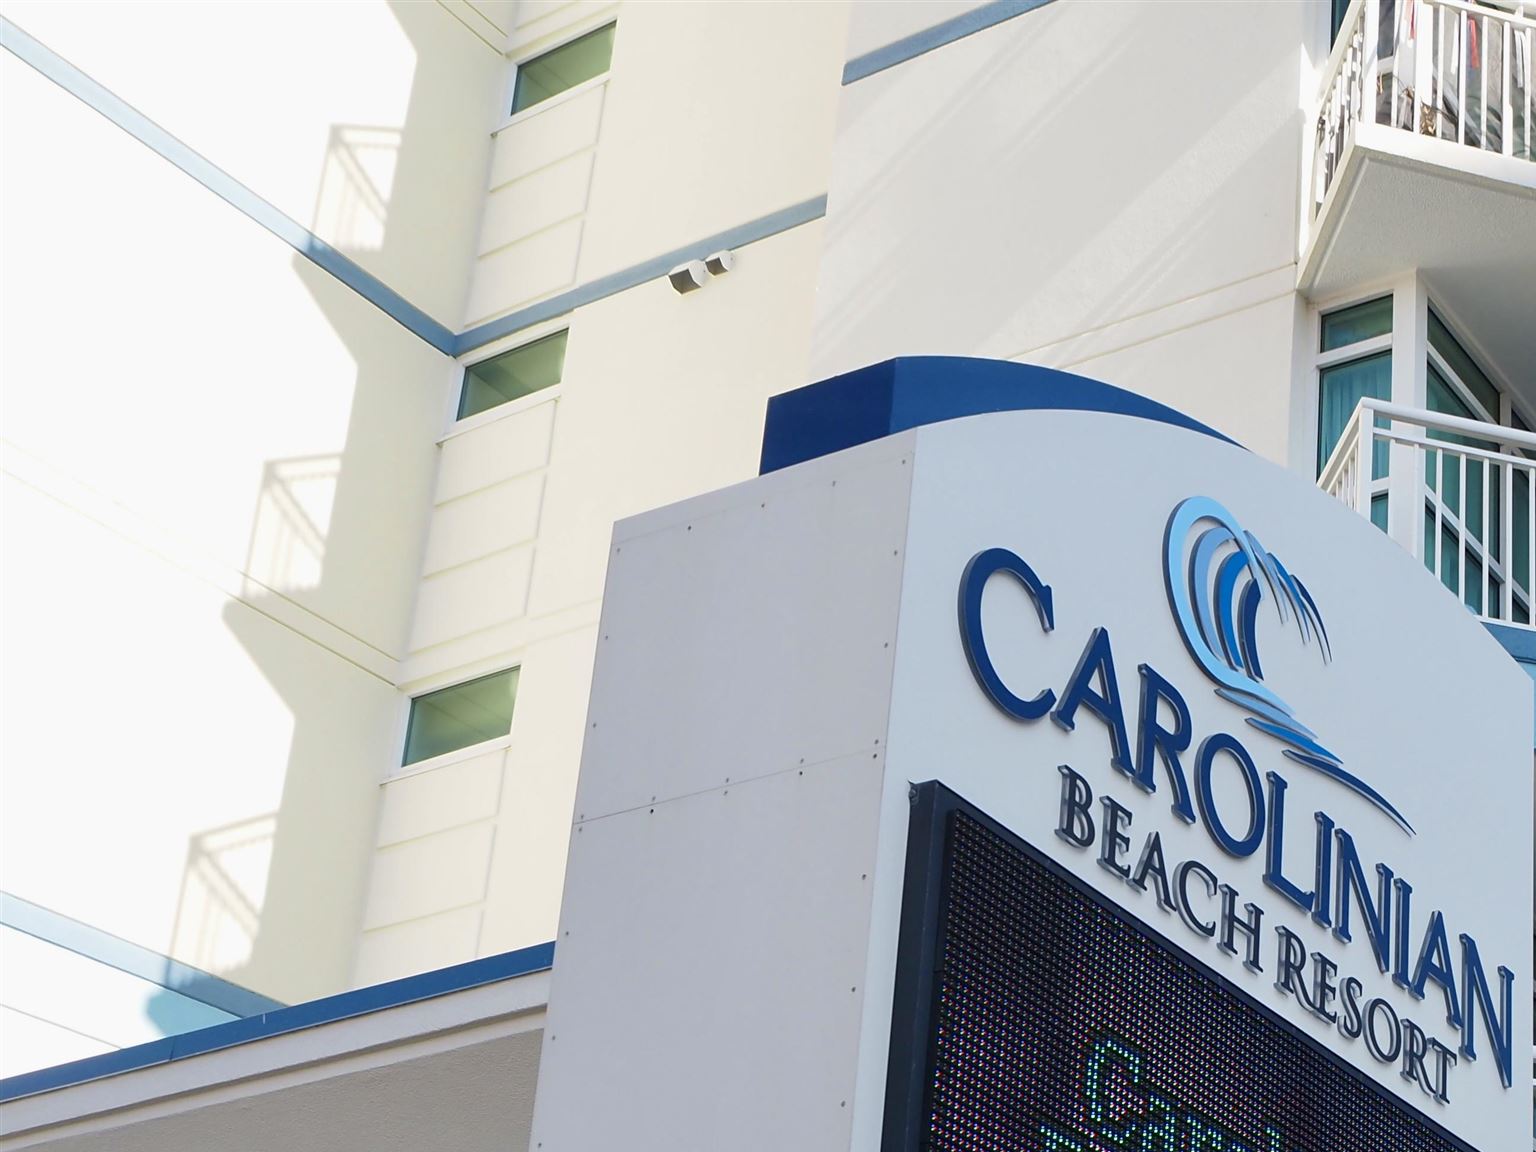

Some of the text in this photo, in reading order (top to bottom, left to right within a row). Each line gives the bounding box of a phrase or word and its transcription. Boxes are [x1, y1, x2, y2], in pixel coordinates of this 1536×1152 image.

[958, 548, 1515, 1088] CAROLINIAN
[1055, 765, 1458, 1104] BEACH RESORT
